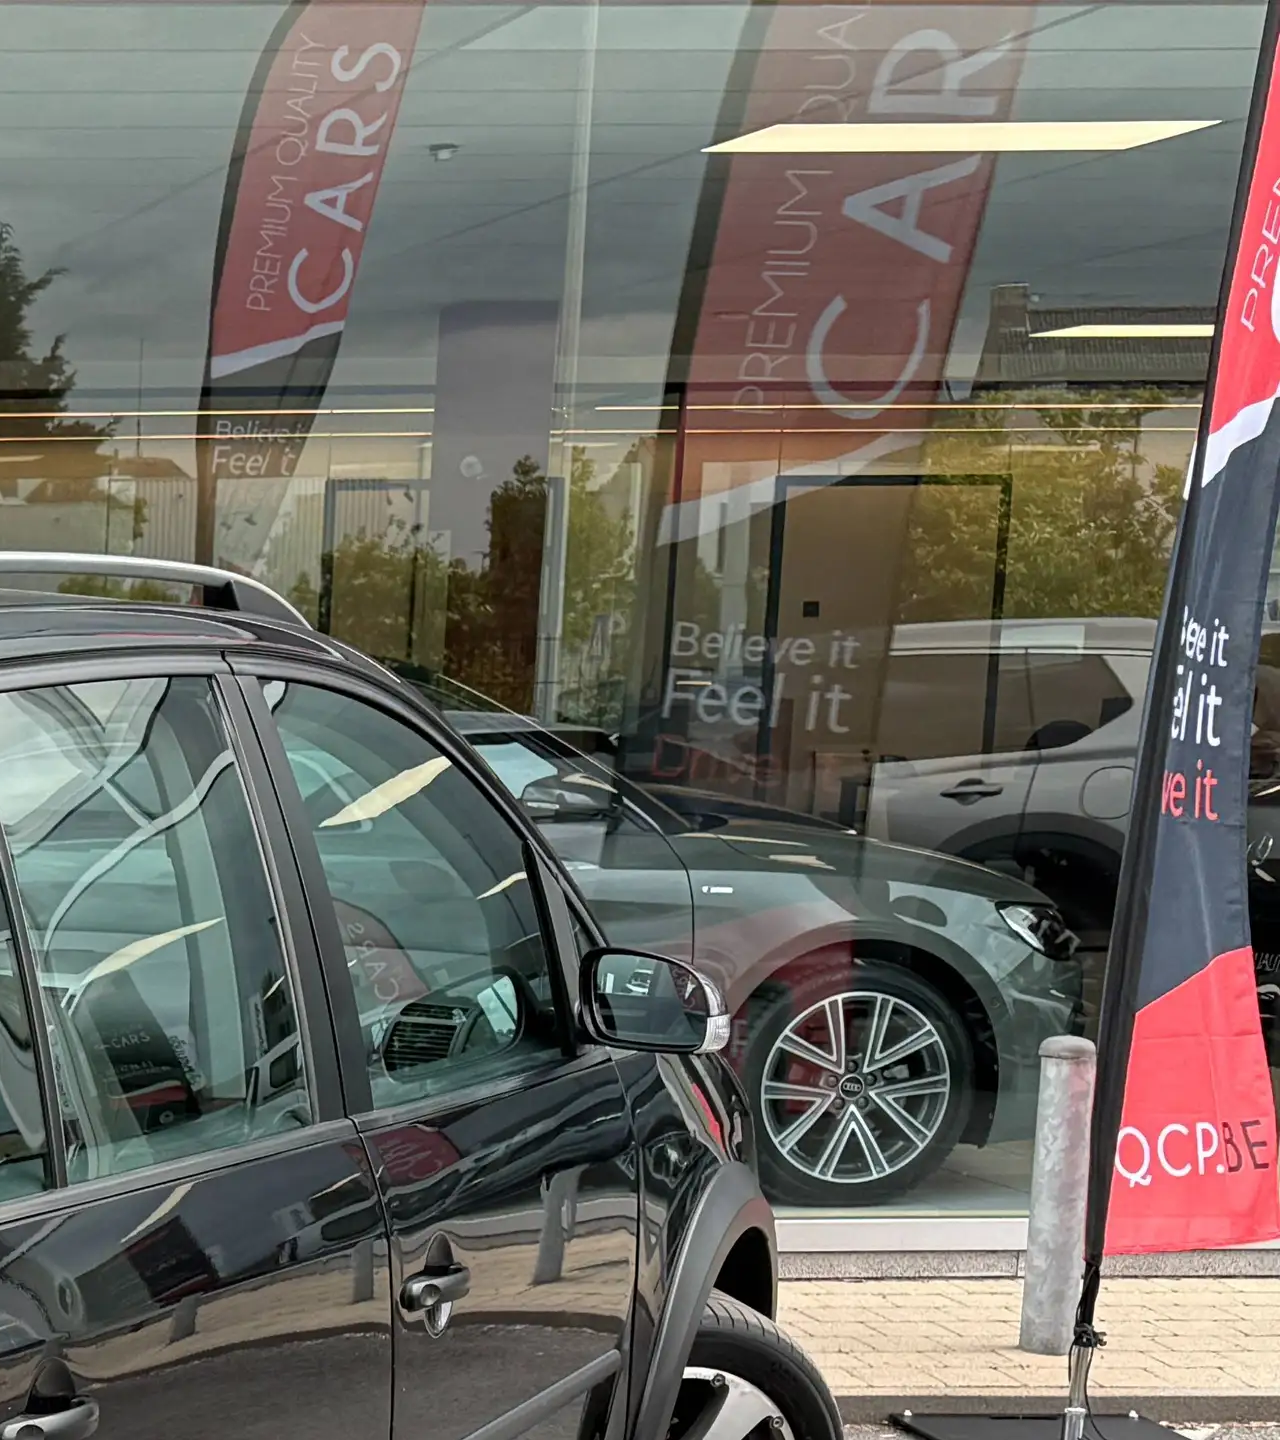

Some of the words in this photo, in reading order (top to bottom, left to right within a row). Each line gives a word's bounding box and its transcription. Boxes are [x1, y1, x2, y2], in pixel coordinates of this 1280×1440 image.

[246, 174, 299, 312] PREMIUM
[276, 31, 327, 167] QUALITY
[287, 41, 402, 314] CARS
[732, 168, 835, 417] PREMIUM
[211, 445, 272, 476] Feel
[670, 621, 816, 666] Believe
[828, 629, 861, 669] it
[1209, 617, 1230, 667] it
[661, 667, 787, 730] Feel
[804, 673, 853, 733] it
[1195, 672, 1223, 747] it
[1193, 758, 1219, 821] it
